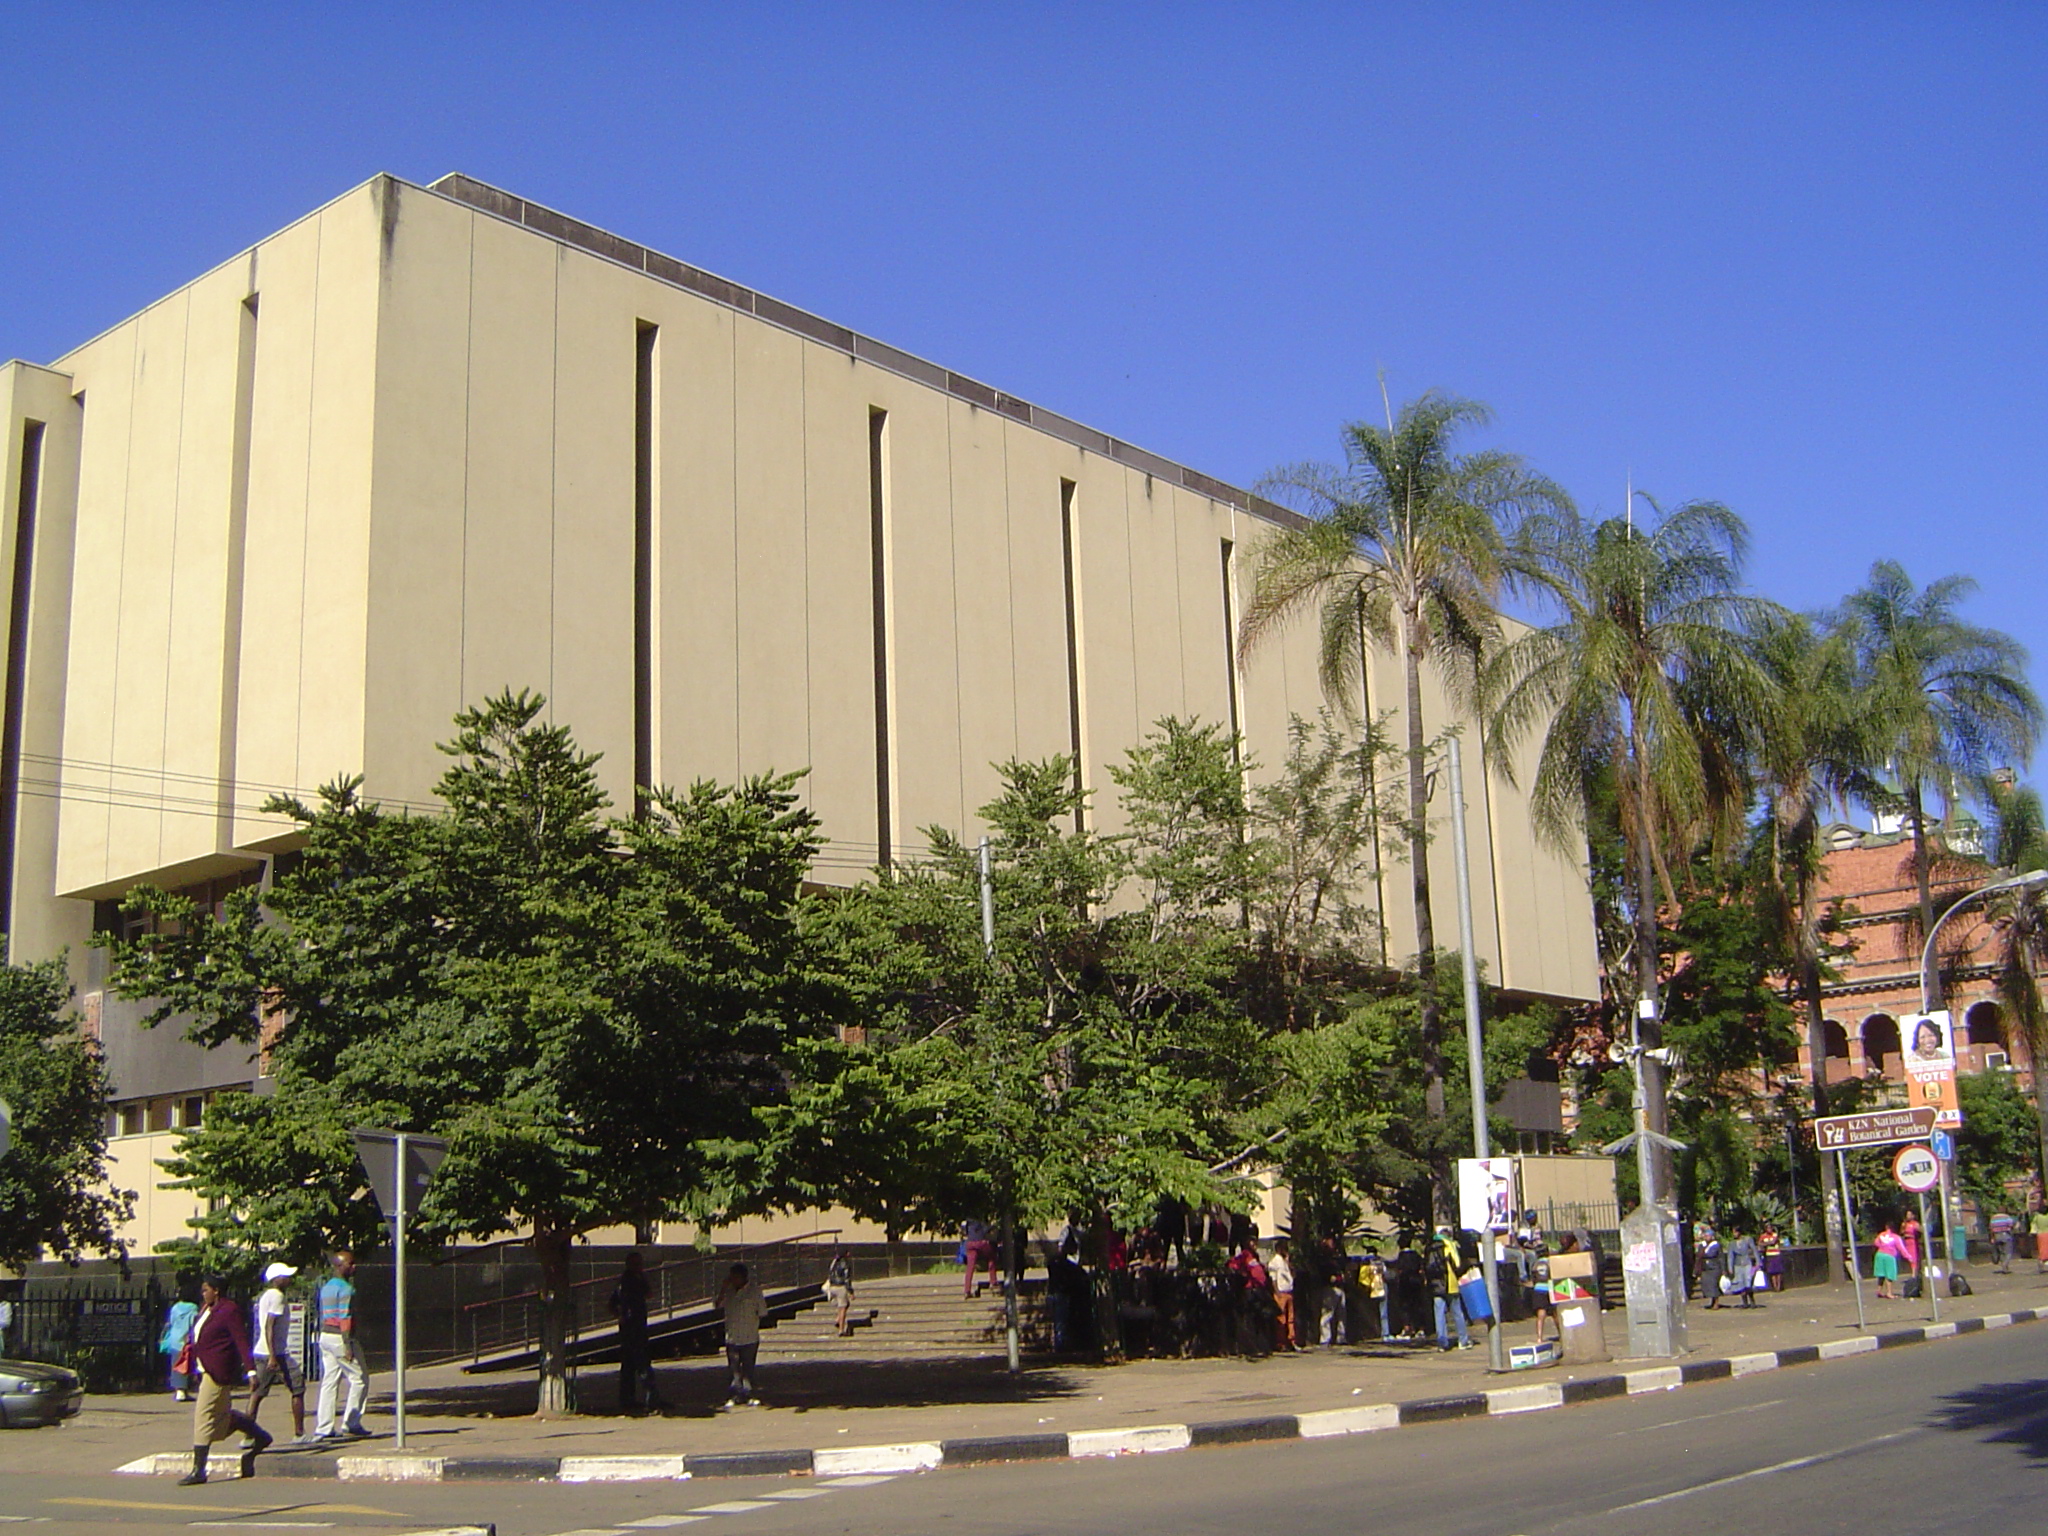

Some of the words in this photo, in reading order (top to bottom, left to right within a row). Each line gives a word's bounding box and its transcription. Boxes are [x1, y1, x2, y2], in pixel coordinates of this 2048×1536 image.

[1913, 1071, 1948, 1082] VOTE
[1848, 1119, 1869, 1130] KZN
[1873, 1112, 1913, 1128] National
[1850, 1128, 1891, 1142] Botanical
[1895, 1123, 1927, 1136] Garden
[1935, 1131, 1944, 1144] P
[95, 1303, 128, 1312] NOTICE
